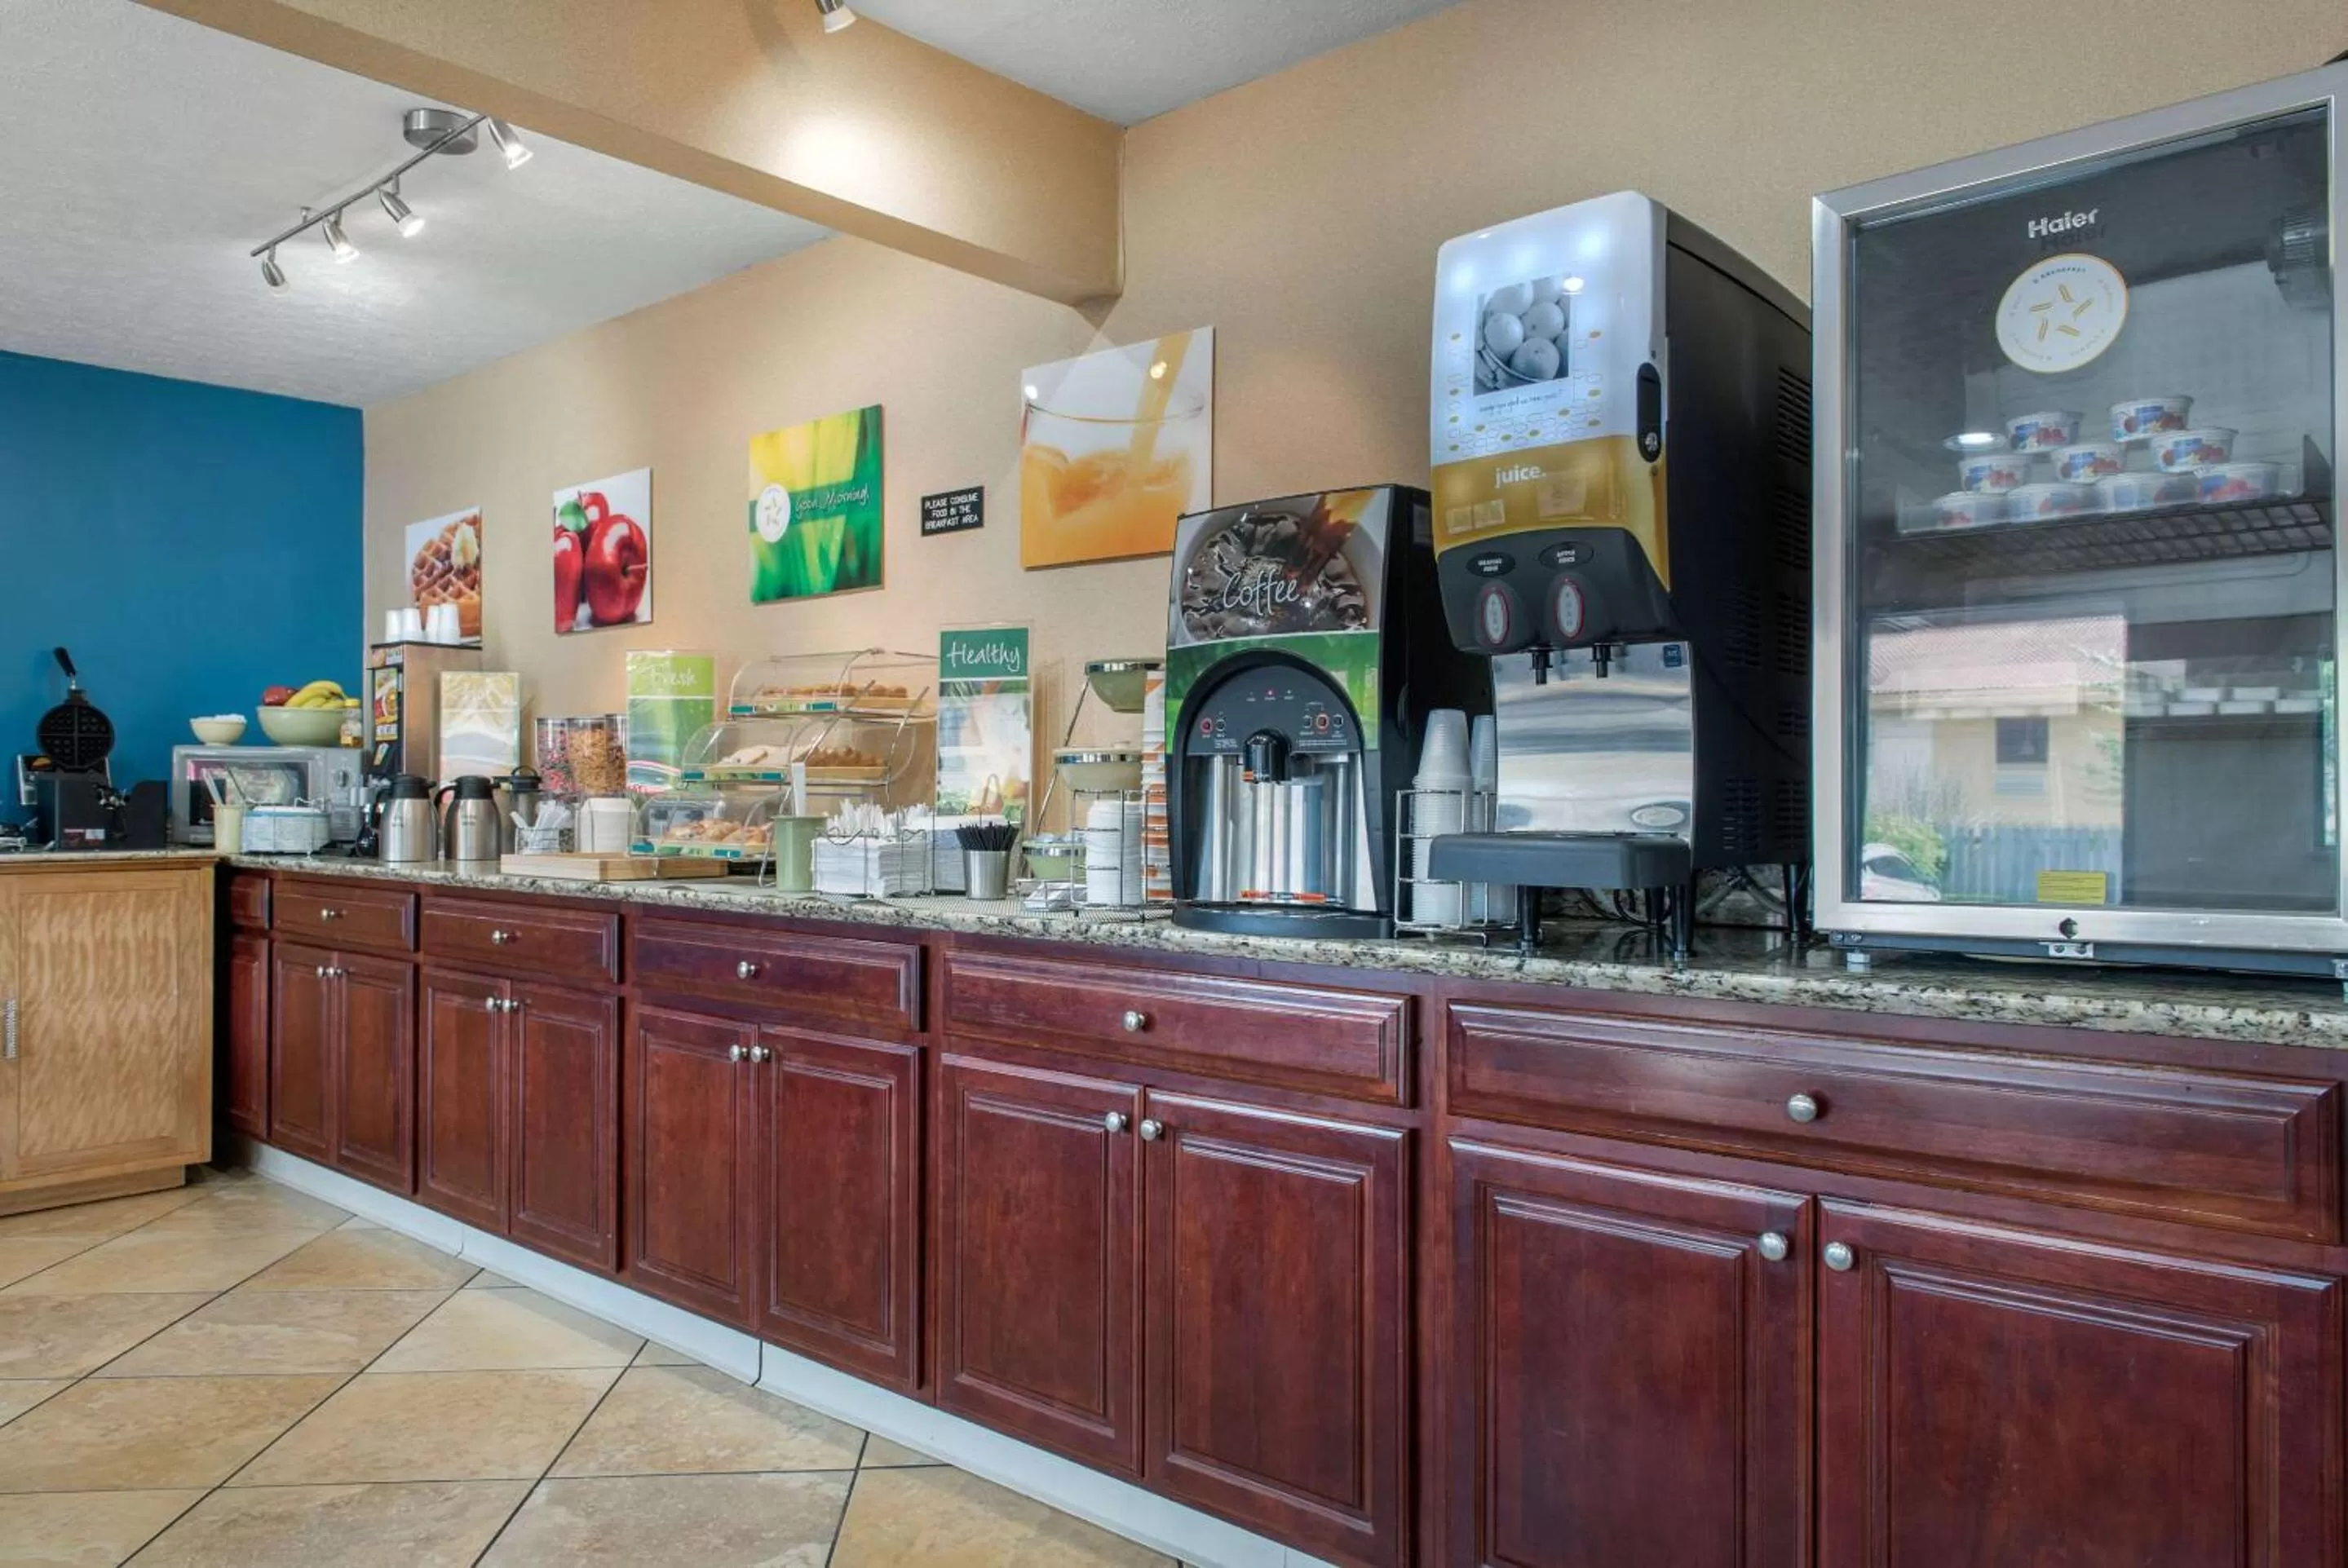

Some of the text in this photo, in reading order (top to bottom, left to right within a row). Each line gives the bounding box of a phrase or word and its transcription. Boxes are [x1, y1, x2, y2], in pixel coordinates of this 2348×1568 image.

[2028, 209, 2099, 238] Haier
[925, 492, 979, 510] PLEASE CONSUME
[932, 504, 971, 518] FOOD IN THE
[925, 513, 979, 529] BREAKFAST AREA
[1223, 567, 1300, 616] Coffee
[946, 641, 1020, 672] Healthy
